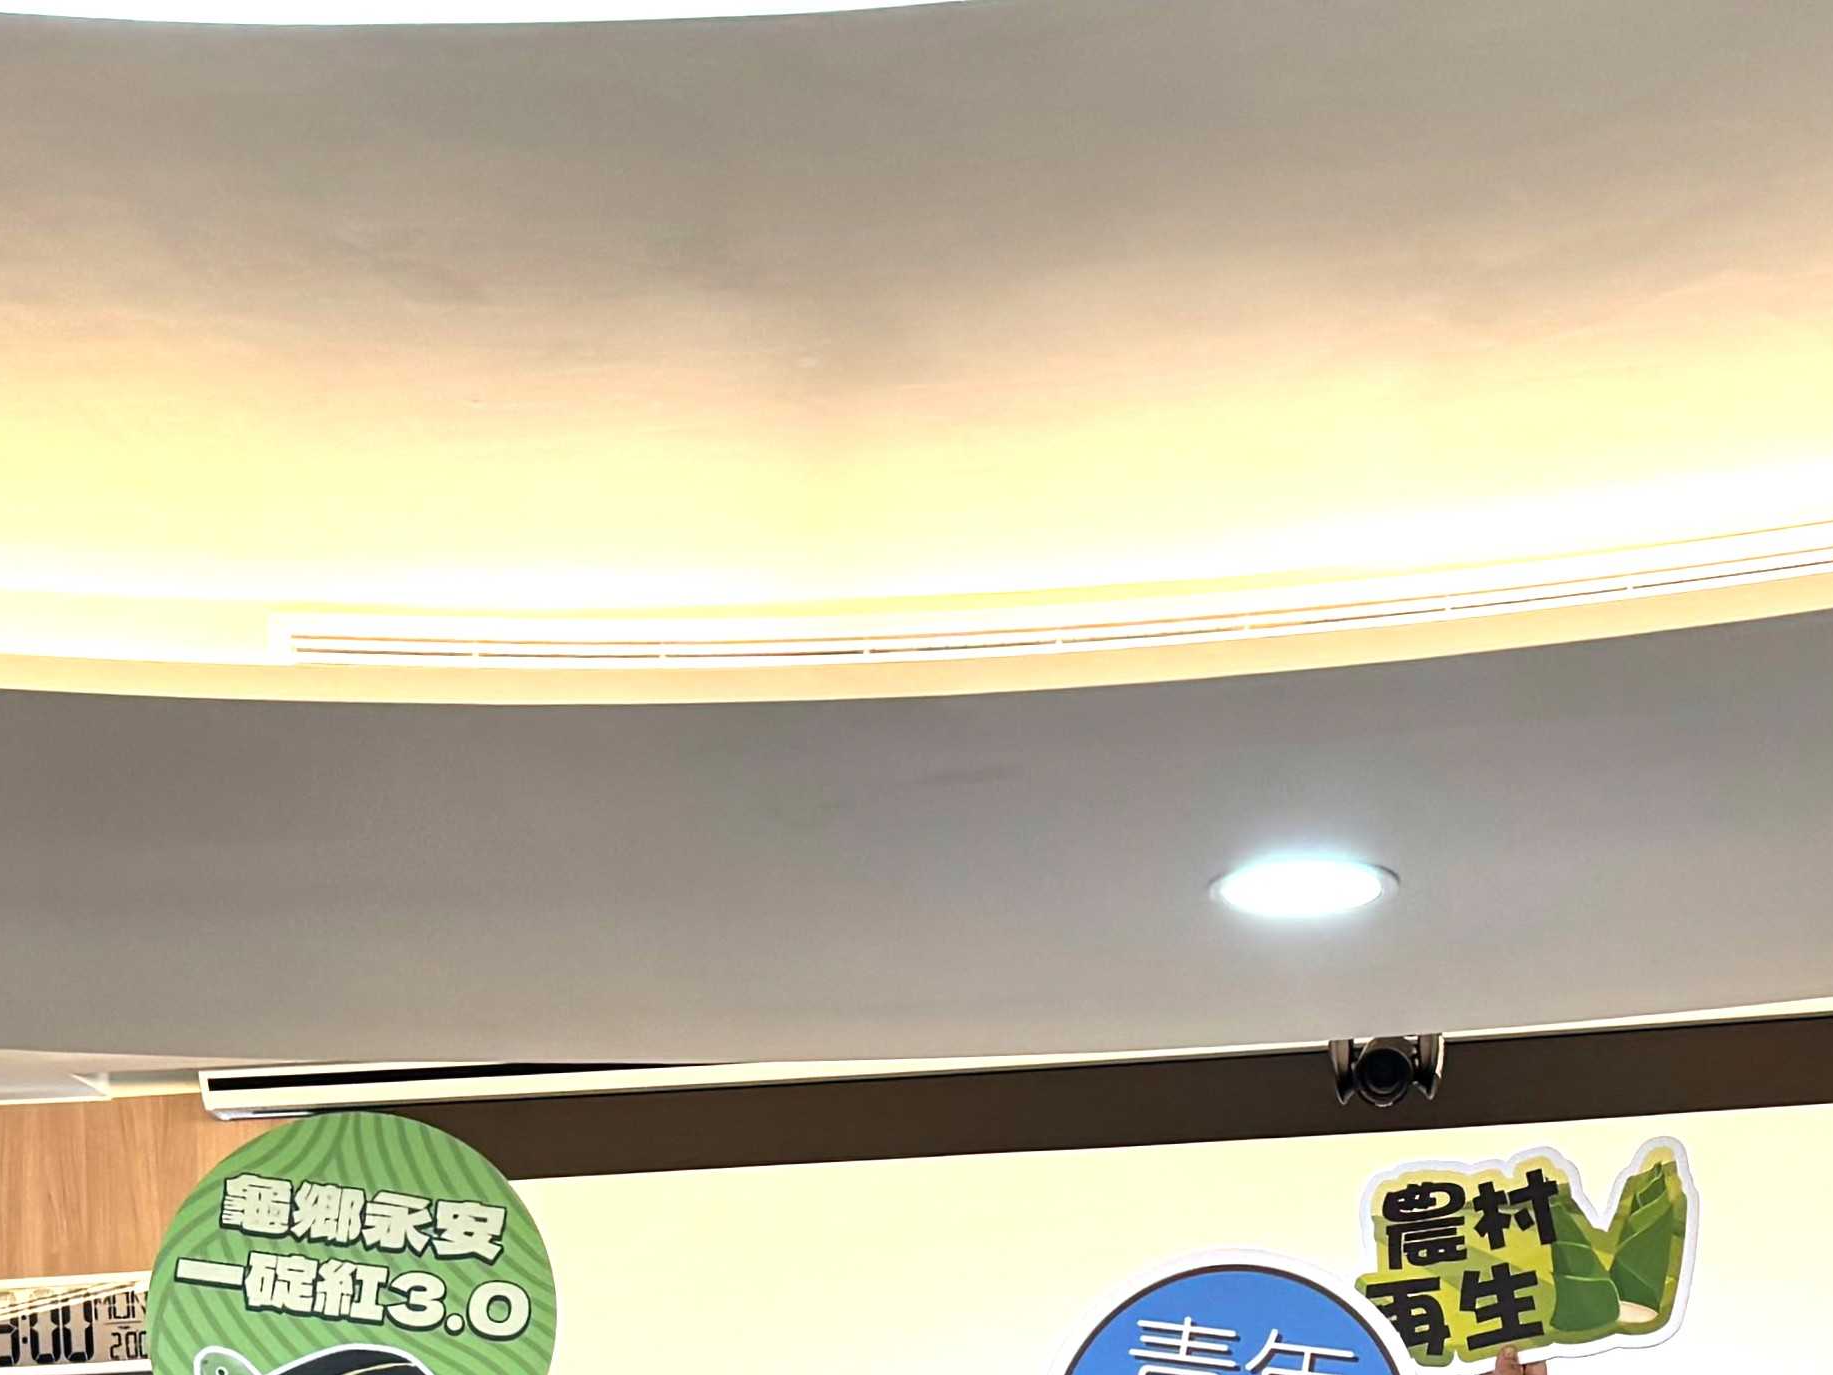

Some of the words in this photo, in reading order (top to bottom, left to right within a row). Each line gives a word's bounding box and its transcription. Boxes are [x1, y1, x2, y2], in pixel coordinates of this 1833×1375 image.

[220, 1174, 507, 1264] 龜鄉永安
[1382, 1168, 1559, 1270] 農村
[175, 1252, 531, 1341] 一碇紅3.0
[1366, 1262, 1545, 1356] 再生
